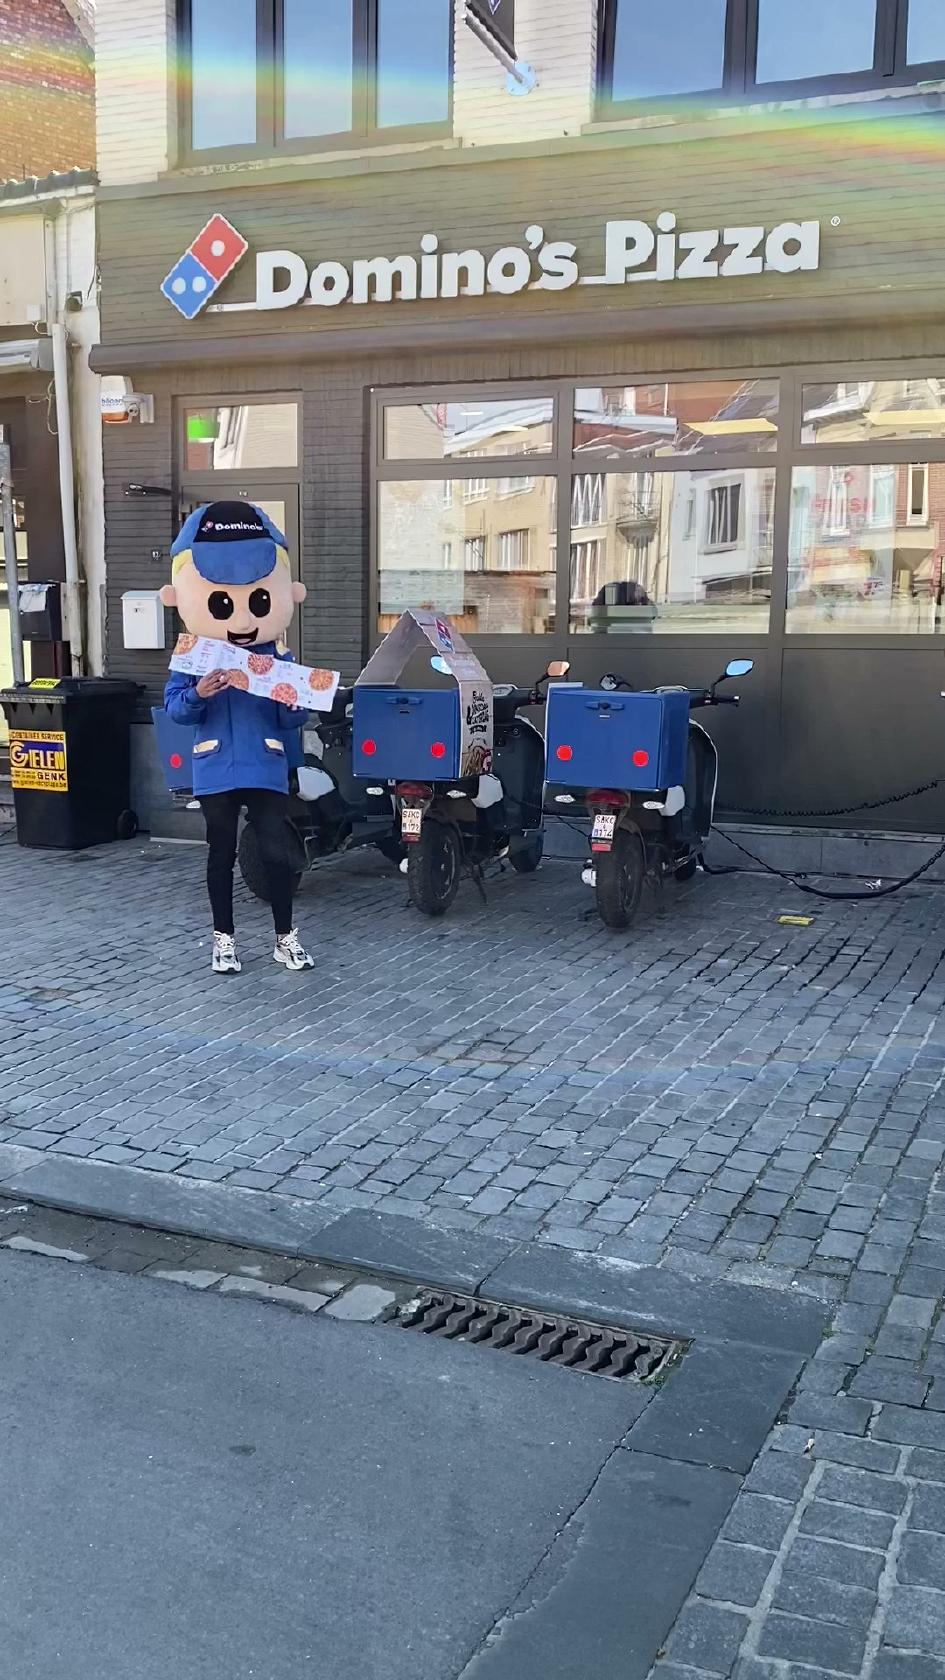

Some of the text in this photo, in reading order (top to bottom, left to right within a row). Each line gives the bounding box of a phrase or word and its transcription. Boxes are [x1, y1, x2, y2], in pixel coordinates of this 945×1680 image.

[256, 211, 820, 310] Domino's Pizza
[214, 521, 264, 531] Domino's
[41, 733, 64, 741] SERVICE
[10, 740, 65, 770] GIELEN
[37, 771, 66, 781] GENK
